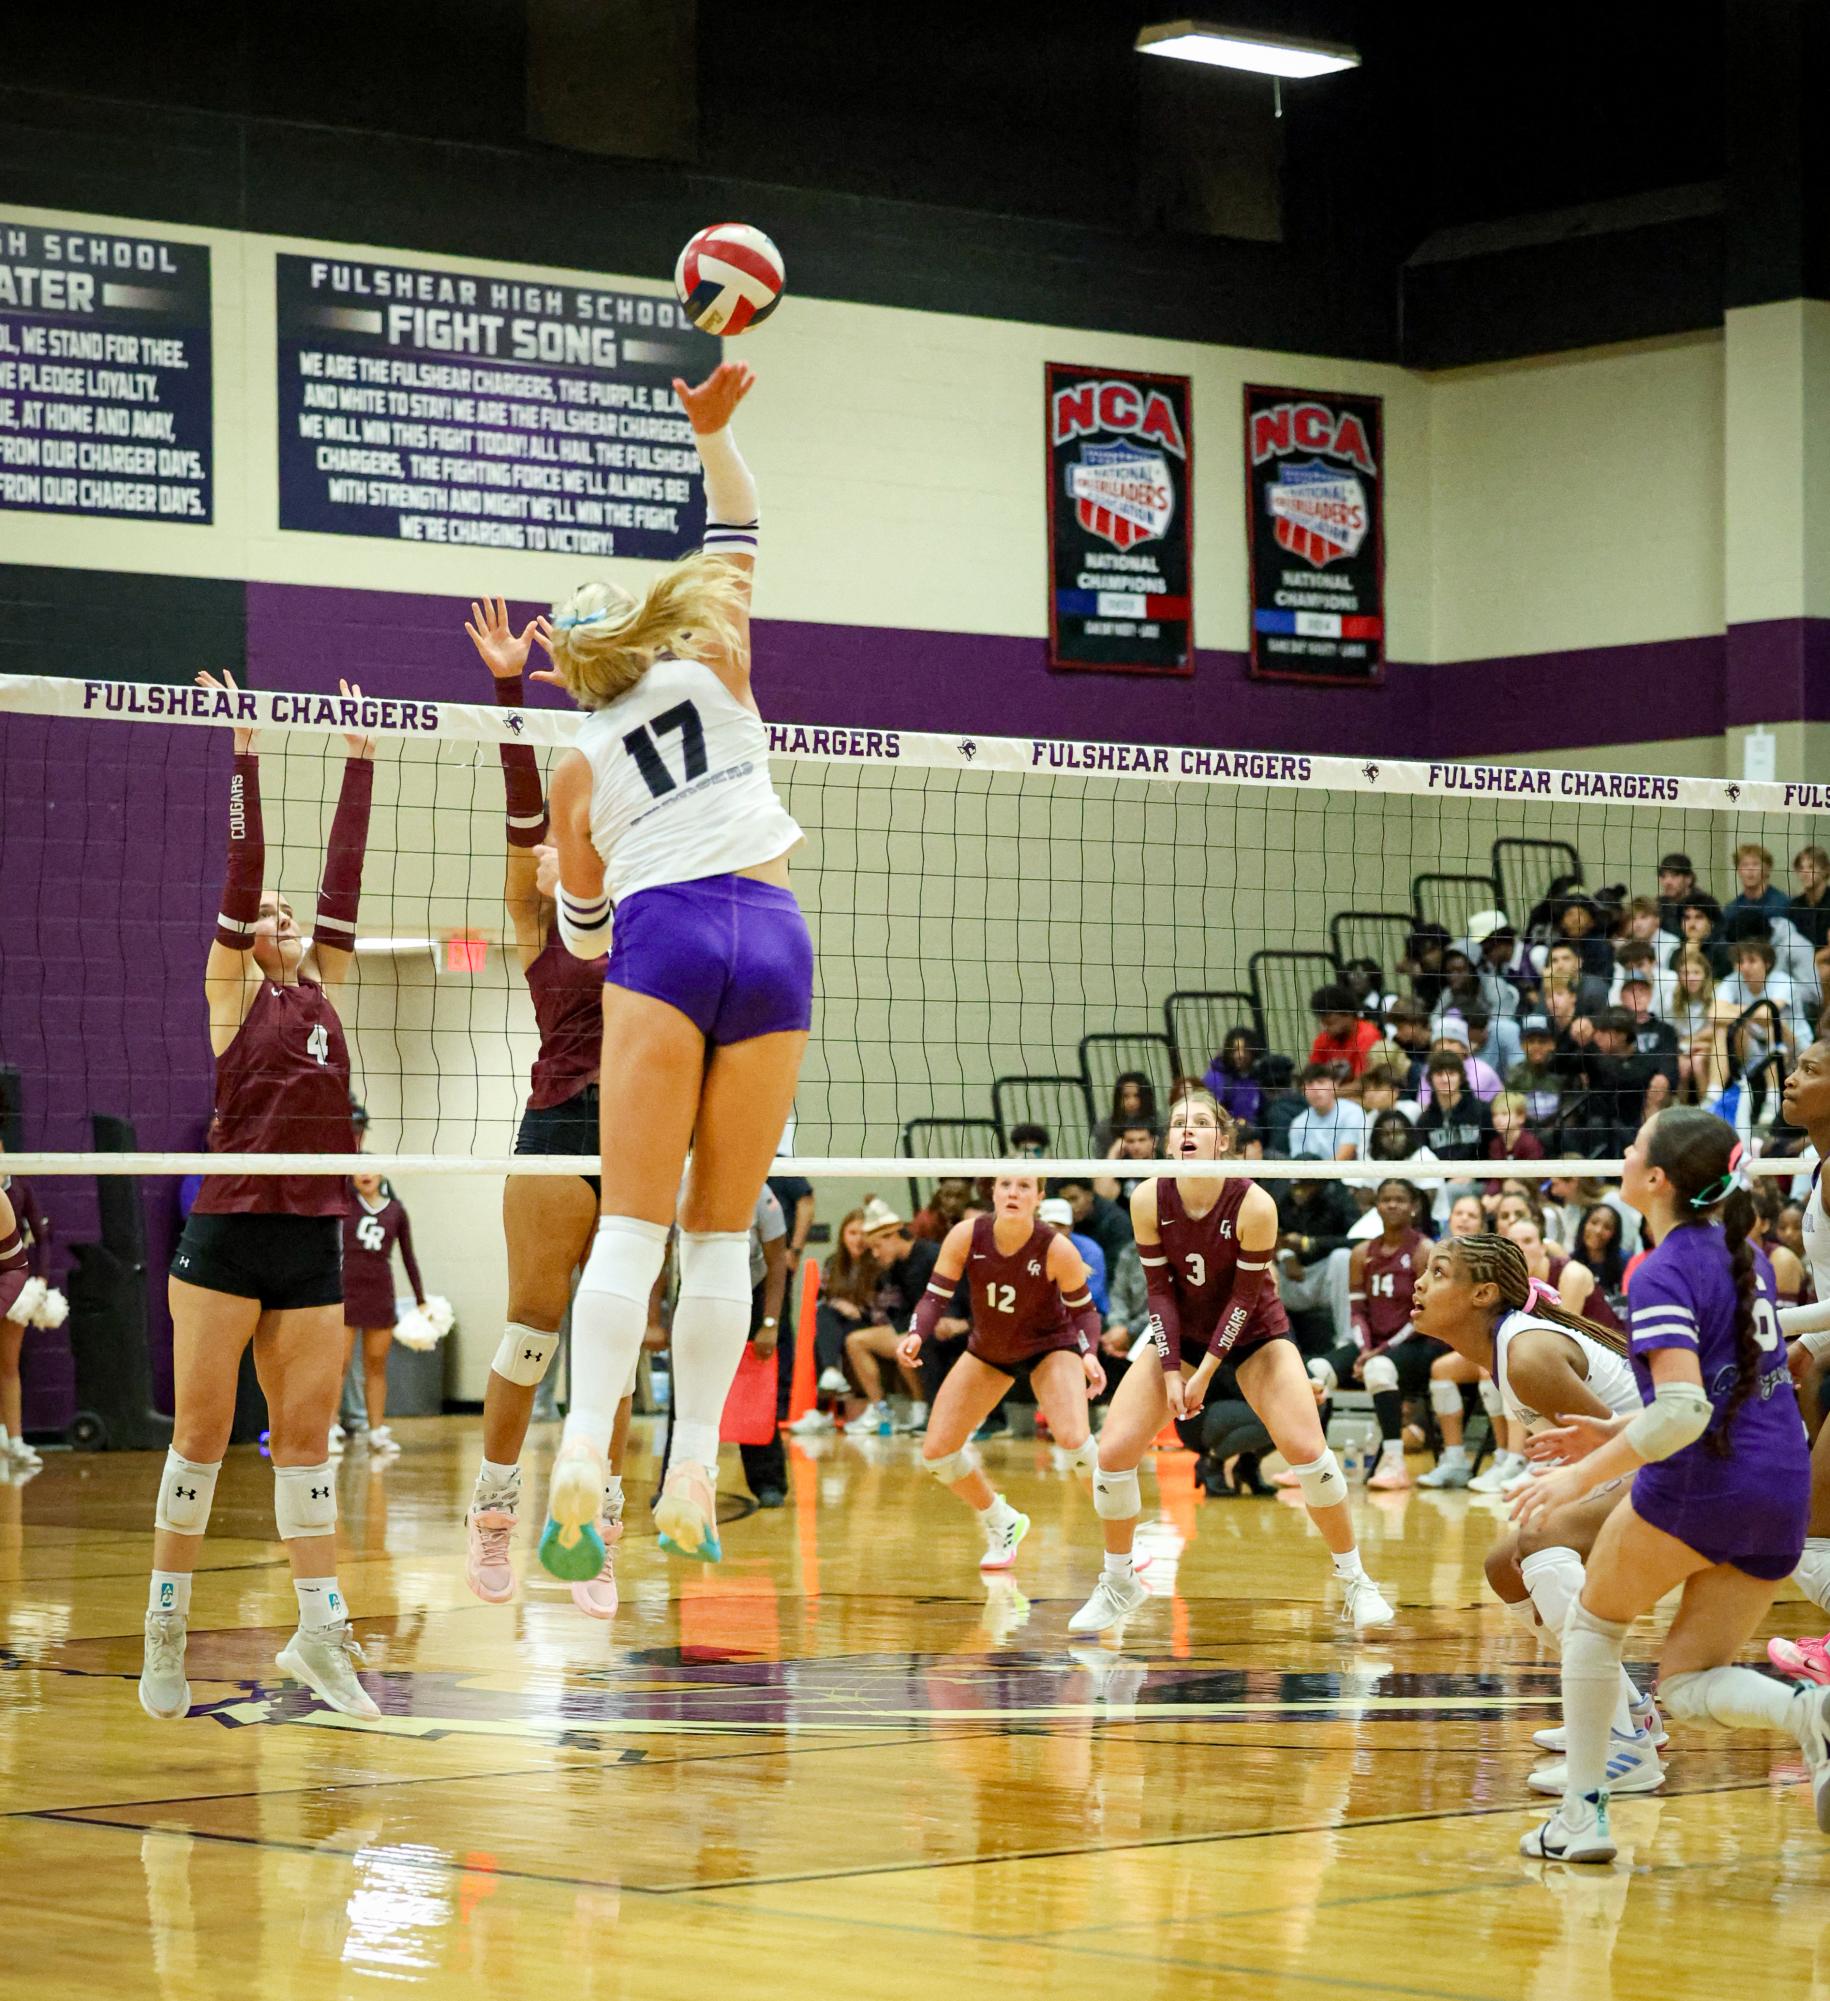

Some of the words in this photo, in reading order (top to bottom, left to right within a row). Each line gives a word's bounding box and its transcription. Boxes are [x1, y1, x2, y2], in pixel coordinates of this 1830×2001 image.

[0, 231, 27, 257] H
[43, 235, 177, 273] SCHOOL
[310, 263, 477, 306] FULSHEAR
[490, 284, 563, 317] HIGH
[576, 293, 693, 330] SCHOOL
[22, 326, 47, 355] WE
[50, 329, 103, 361] STAND
[104, 334, 139, 364] FOR
[140, 337, 189, 370] THEE.
[388, 304, 505, 355] FIGHT
[511, 317, 617, 369] SONG
[18, 363, 85, 396] PLEDGE
[87, 369, 160, 403] LOYALTY.
[300, 351, 323, 378] WE
[325, 354, 357, 381] ARE
[358, 358, 389, 384] THE
[391, 361, 471, 393] FULSHEAR
[472, 370, 557, 404] CHARGERS,
[558, 378, 588, 405] THE
[22, 401, 43, 430] AT
[45, 402, 93, 434] HOME
[95, 406, 130, 437] AND
[131, 410, 176, 443] AWAY,
[304, 383, 338, 410] AND
[339, 386, 386, 414] WHITE
[388, 391, 409, 417] TO
[452, 397, 475, 423] WE
[477, 399, 508, 426] ARE
[509, 403, 539, 429] THE
[540, 407, 617, 437] FULSHEAR
[1053, 381, 1186, 460] NCA
[42, 439, 77, 469] OUR
[79, 442, 157, 476] CHARGER
[158, 449, 206, 480] DAYS.
[299, 413, 323, 439] WE
[324, 416, 361, 443] WILL
[361, 419, 391, 445] WIN
[391, 421, 428, 449] THIS
[429, 425, 475, 453] FIGHT
[529, 436, 559, 461] ALL
[559, 438, 594, 465] HAIL
[595, 442, 625, 468] THE
[626, 445, 701, 475] FULSHEAR
[1252, 402, 1377, 477] NCA
[316, 446, 405, 479] CHARGERS,
[409, 454, 441, 480] THE
[442, 457, 511, 486] FIGHTING
[511, 465, 561, 491] FORCE
[607, 473, 664, 501] ALWAYS
[42, 476, 77, 507] OUR
[79, 479, 157, 512] CHARGER
[158, 485, 206, 516] DAYS.
[328, 478, 367, 504] WITH
[368, 482, 448, 511] STRENGTH
[450, 488, 482, 514] AND
[482, 491, 530, 518] MIGHT
[575, 501, 602, 525] WIN
[603, 503, 633, 528] THE
[449, 519, 525, 549] CHARGING
[525, 525, 547, 550] TO
[1077, 572, 1167, 594] CHAMPIONS
[1085, 552, 1160, 573] NATIONAL
[1274, 589, 1359, 611] CHAMPIONS
[83, 681, 258, 721] FULSHEAR
[271, 695, 439, 731] CHARGERS
[621, 698, 708, 799] 17
[764, 725, 900, 758] HARGERS
[1032, 741, 1169, 773] FULSHEAR
[1181, 750, 1312, 781] CHARGERS
[1428, 764, 1551, 794] FULSHEAR
[1561, 772, 1679, 801] CHARGERS
[229, 774, 245, 840] COUGARS
[307, 1023, 328, 1066] 4
[1185, 1252, 1206, 1287] 3
[1371, 1273, 1394, 1298] 14
[986, 1281, 1017, 1314] 12
